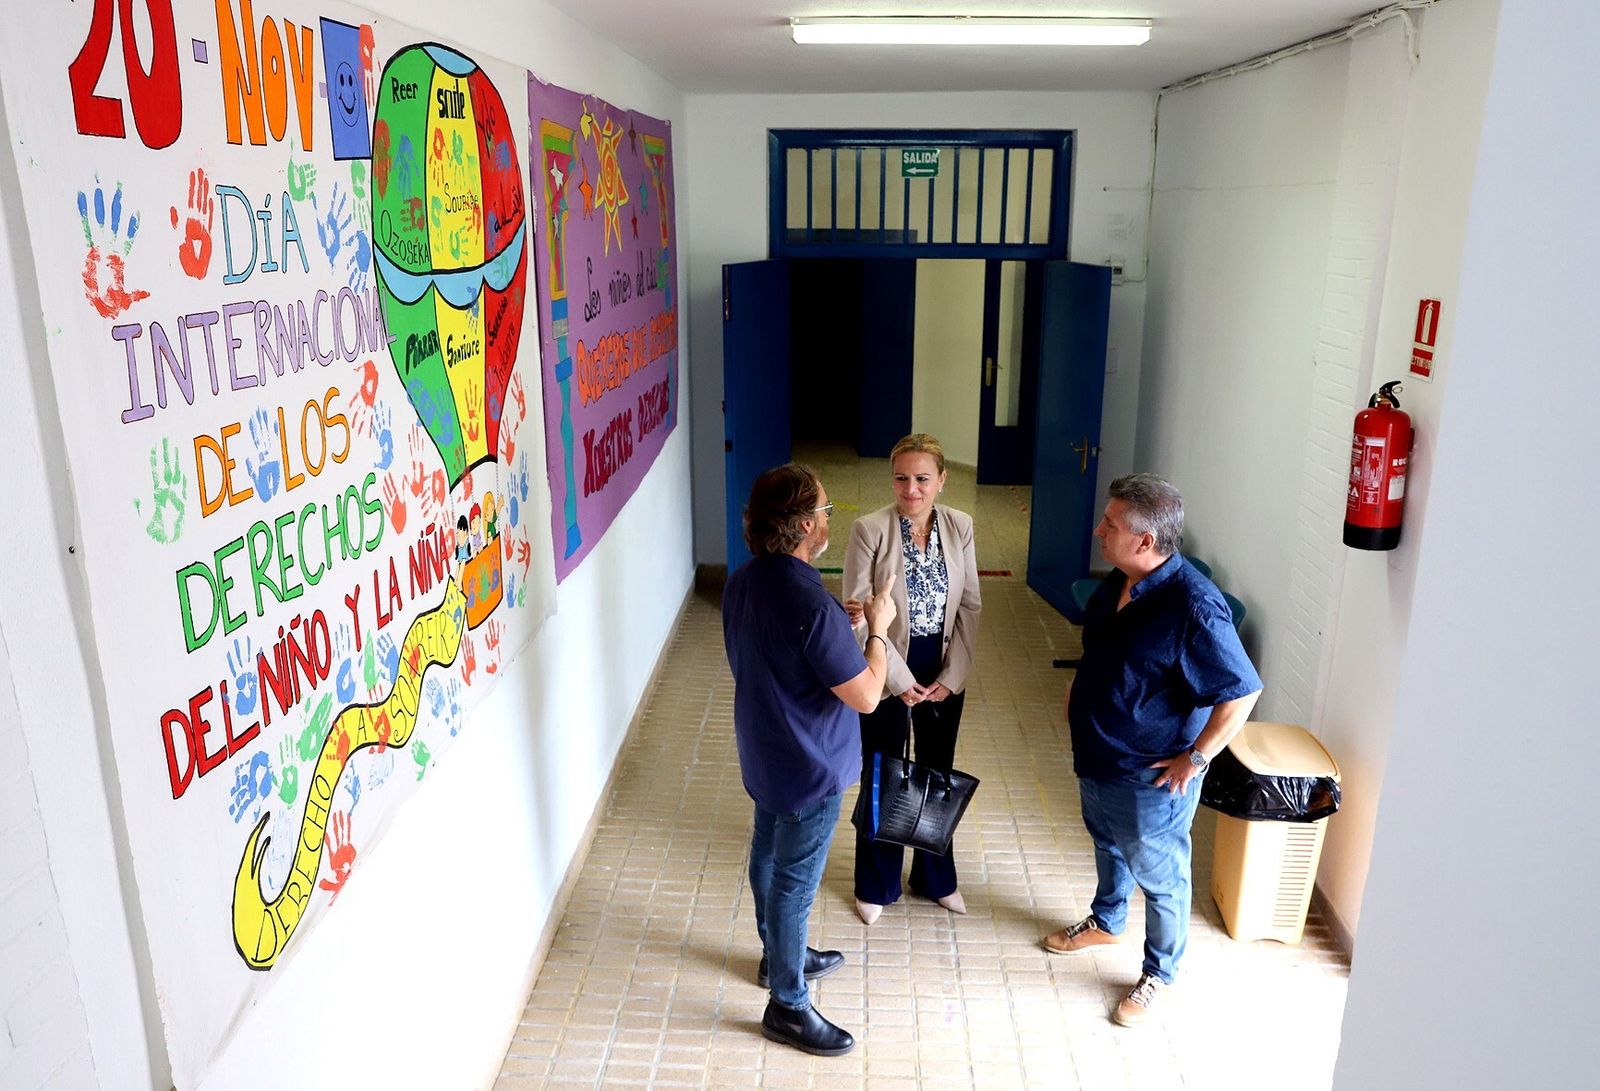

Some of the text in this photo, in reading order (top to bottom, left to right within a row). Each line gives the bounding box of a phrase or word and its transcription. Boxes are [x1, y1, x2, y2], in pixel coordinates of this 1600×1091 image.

[68, 0, 182, 150] 20
[903, 151, 938, 164] SALIDA
[111, 286, 398, 424] INTERNACIONAL
[193, 386, 351, 518] DE LOS
[175, 472, 385, 654] DERECHOS
[160, 522, 452, 800] DEL NIÑO Y LA NIÑA
[250, 774, 332, 963] DERECHO
[355, 709, 369, 745] A
